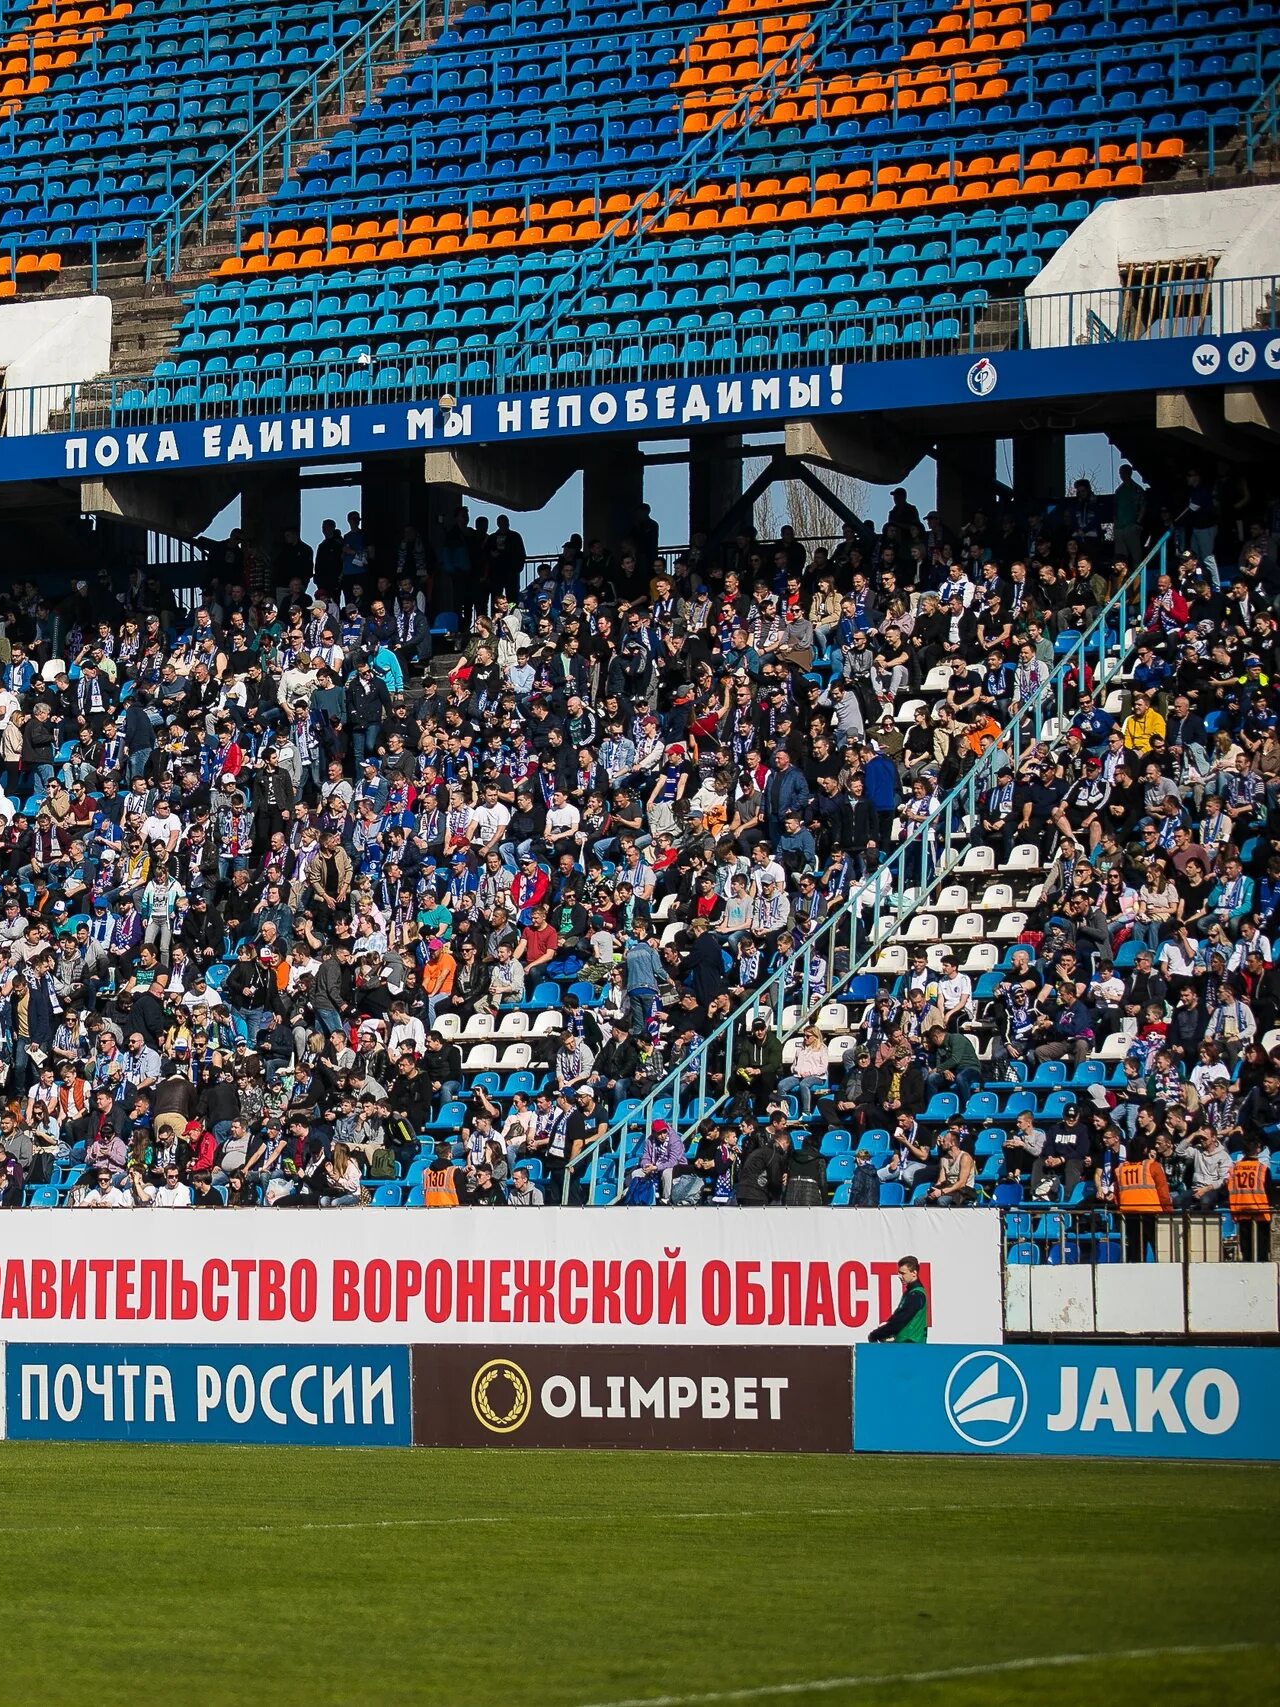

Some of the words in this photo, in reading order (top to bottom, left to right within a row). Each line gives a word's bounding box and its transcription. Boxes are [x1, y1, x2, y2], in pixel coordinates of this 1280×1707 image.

[63, 429, 179, 470] ПОКА
[203, 415, 350, 462] ЕДИНЫ
[407, 402, 471, 441] МЫ
[498, 365, 843, 433] НЕПОБЕДИМЫ!
[427, 1172, 445, 1187] 130
[1123, 1168, 1139, 1185] 111
[332, 1247, 686, 1325] ВОРОНЕЖСКОЙ
[701, 1260, 933, 1328] ОБЛАСТ
[21, 1363, 176, 1422] ПОЧТА
[196, 1364, 395, 1425] РОССИИ
[540, 1375, 789, 1420] OLIMPBET
[1047, 1366, 1240, 1435] JAKO
